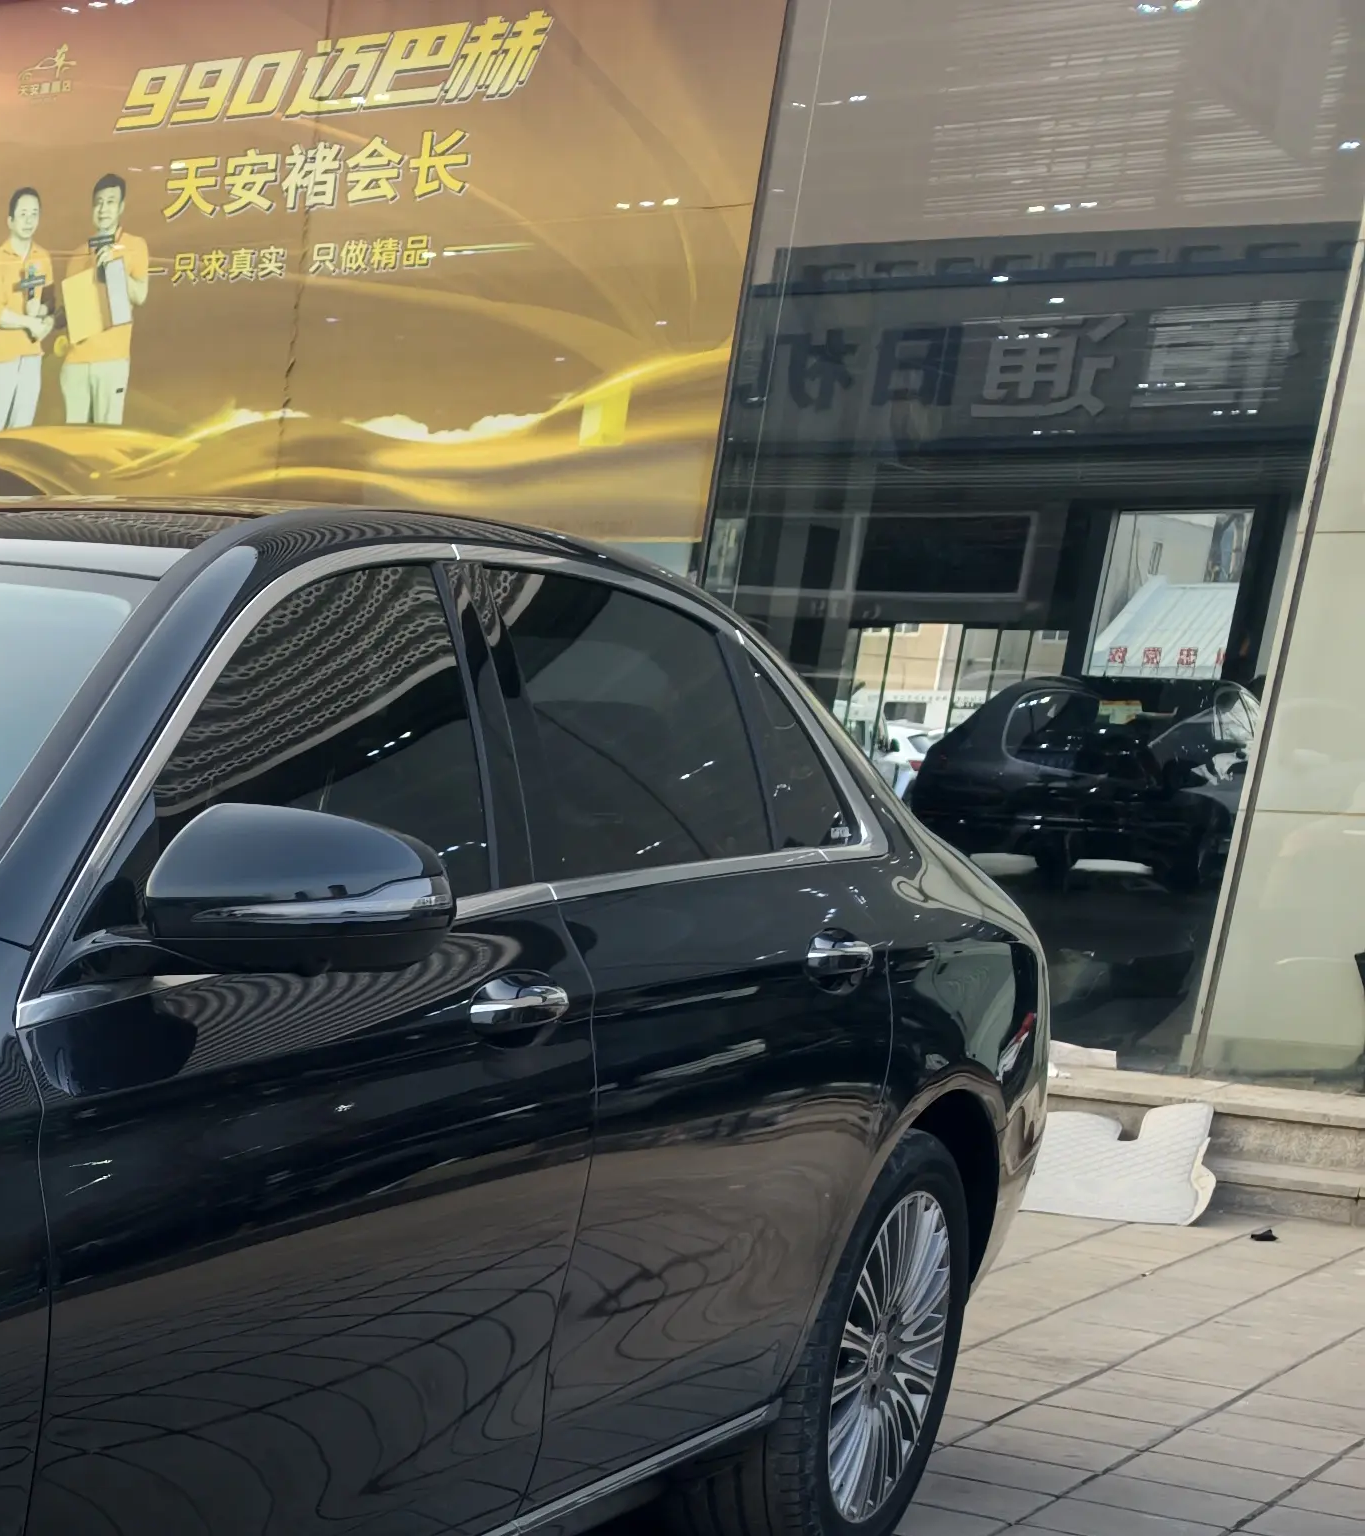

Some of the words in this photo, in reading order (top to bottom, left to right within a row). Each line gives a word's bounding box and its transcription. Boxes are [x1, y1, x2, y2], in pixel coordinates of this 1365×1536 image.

[114, 9, 554, 133] 990迈巴赫
[162, 129, 470, 221] 天安褚会长
[171, 244, 287, 285] 只求真实
[309, 234, 432, 275] 只做精品
